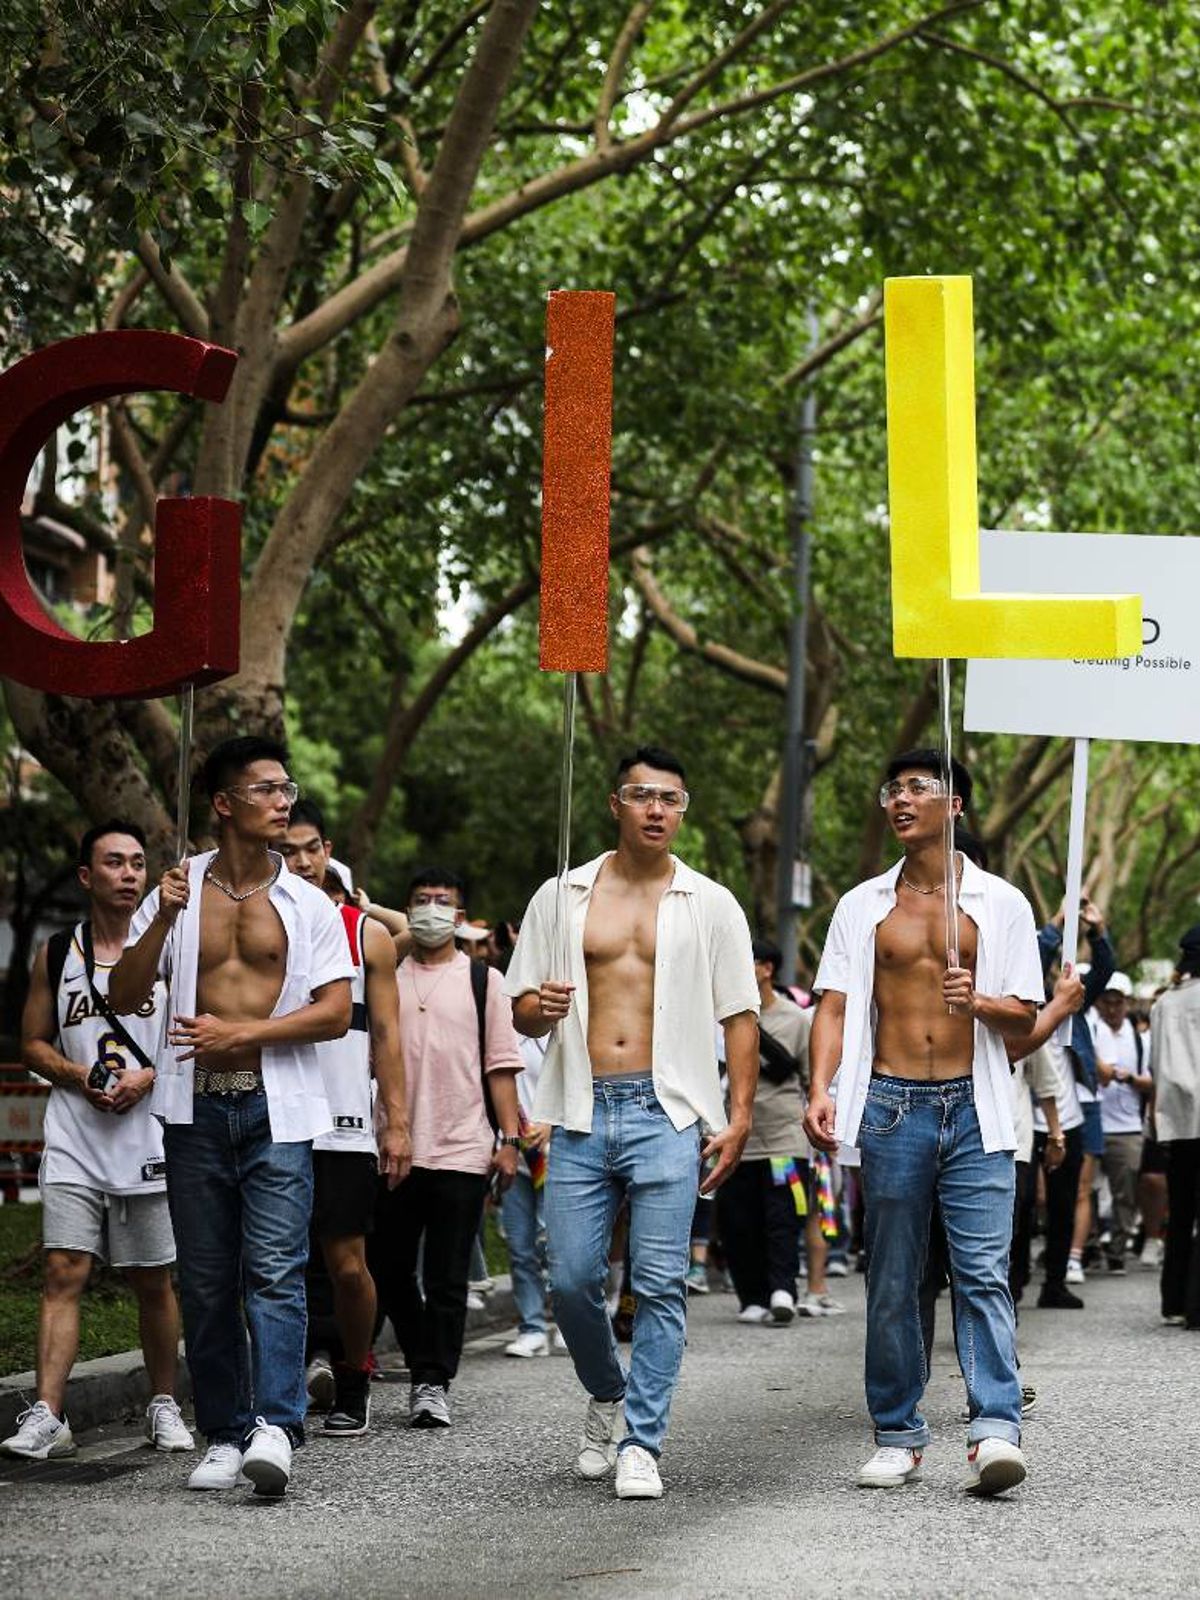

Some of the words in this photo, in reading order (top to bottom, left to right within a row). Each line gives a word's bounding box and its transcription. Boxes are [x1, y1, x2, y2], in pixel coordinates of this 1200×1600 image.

[1135, 654, 1192, 670] Possible
[63, 990, 156, 1029] LAS
[97, 1032, 127, 1071] 6
